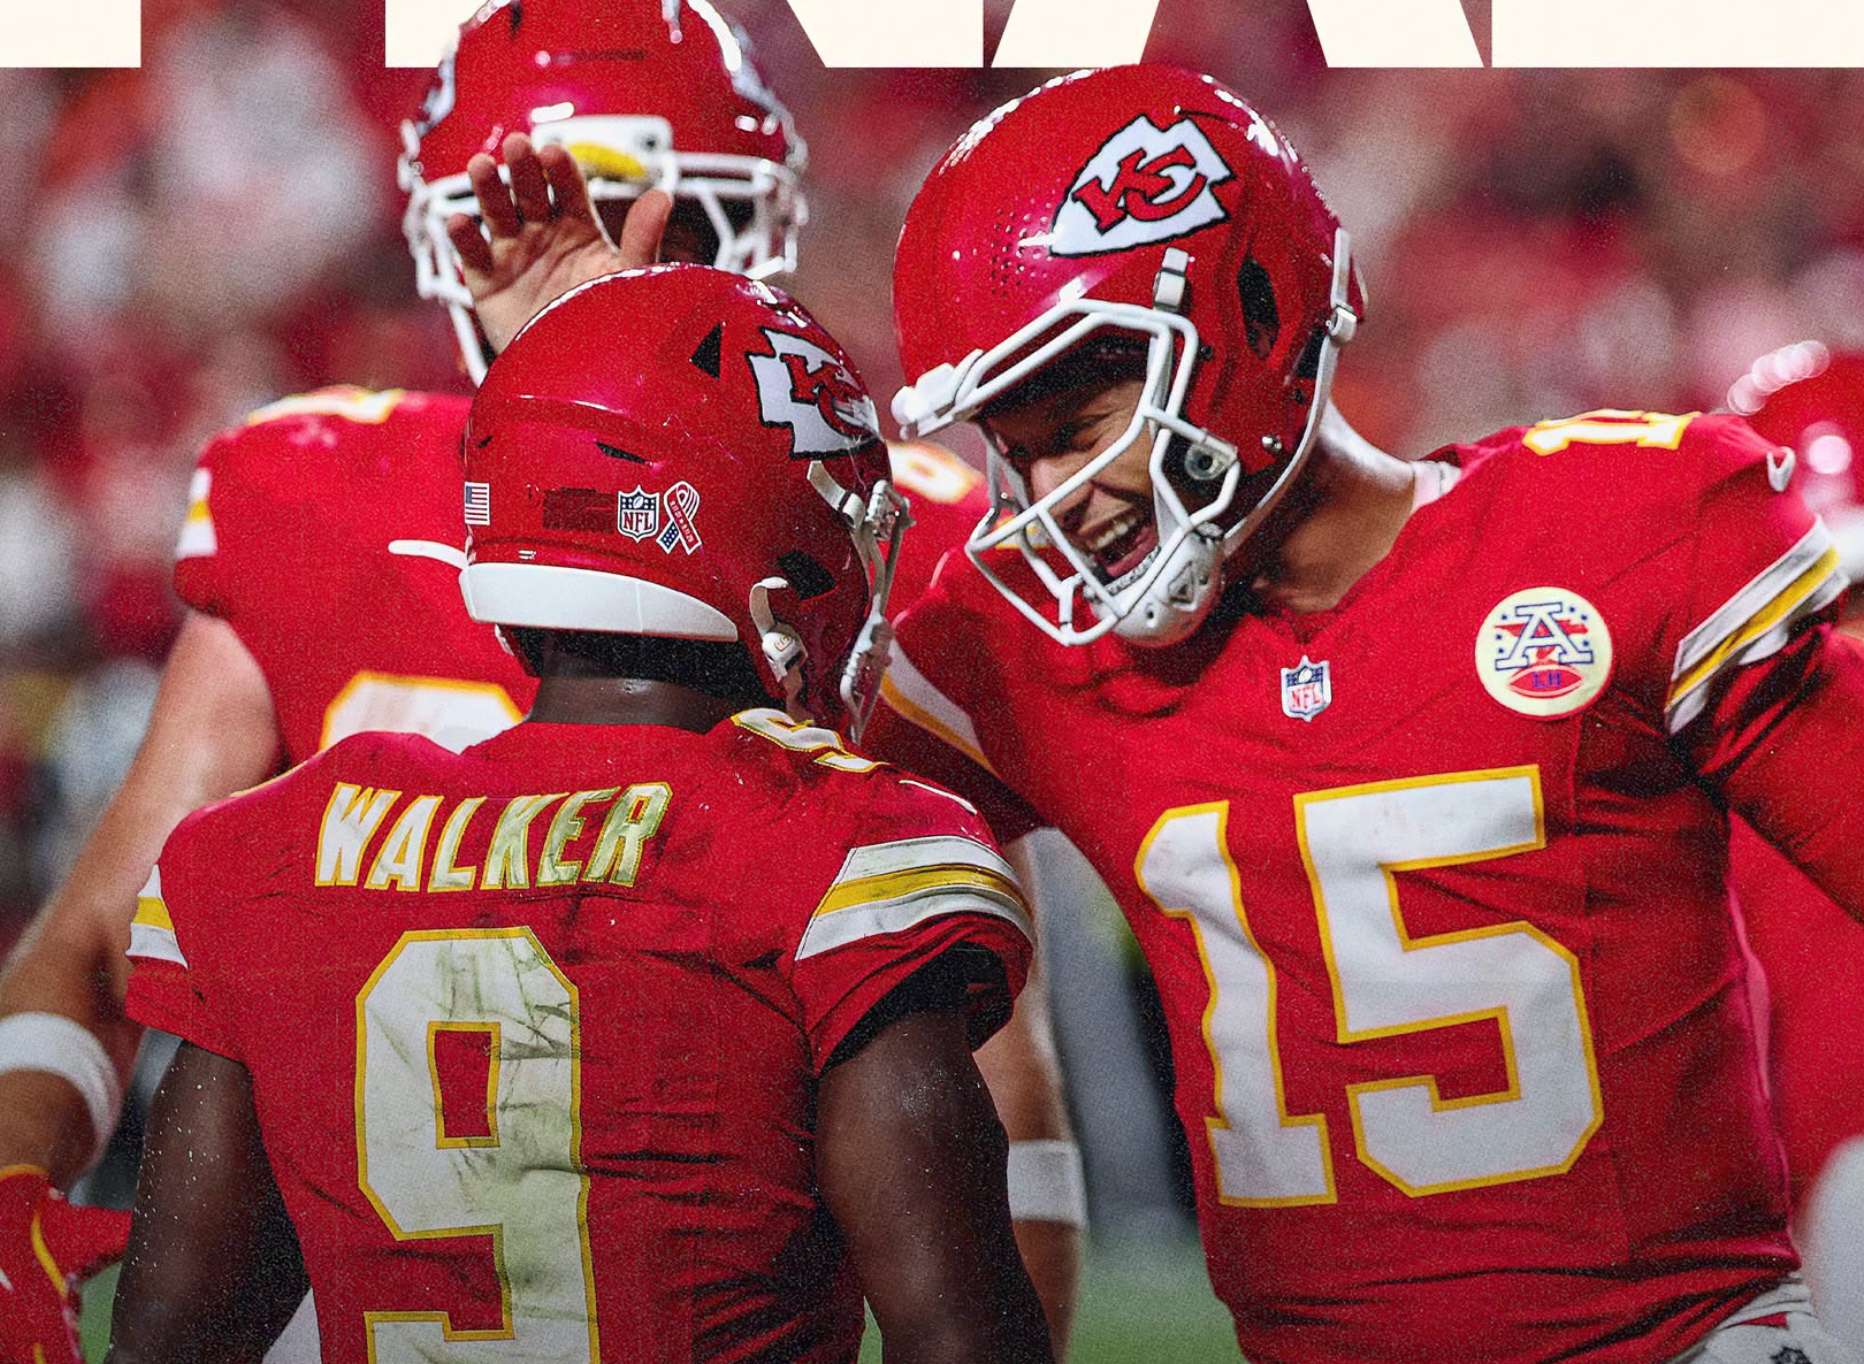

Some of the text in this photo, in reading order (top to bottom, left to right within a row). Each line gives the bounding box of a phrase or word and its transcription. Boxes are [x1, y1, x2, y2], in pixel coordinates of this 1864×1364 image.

[623, 510, 653, 533] NFL
[1290, 683, 1322, 710] NFL
[1531, 670, 1563, 689] LH
[313, 780, 674, 893] WALKER
[1133, 763, 1605, 1210] 15
[354, 925, 601, 1364] 9
